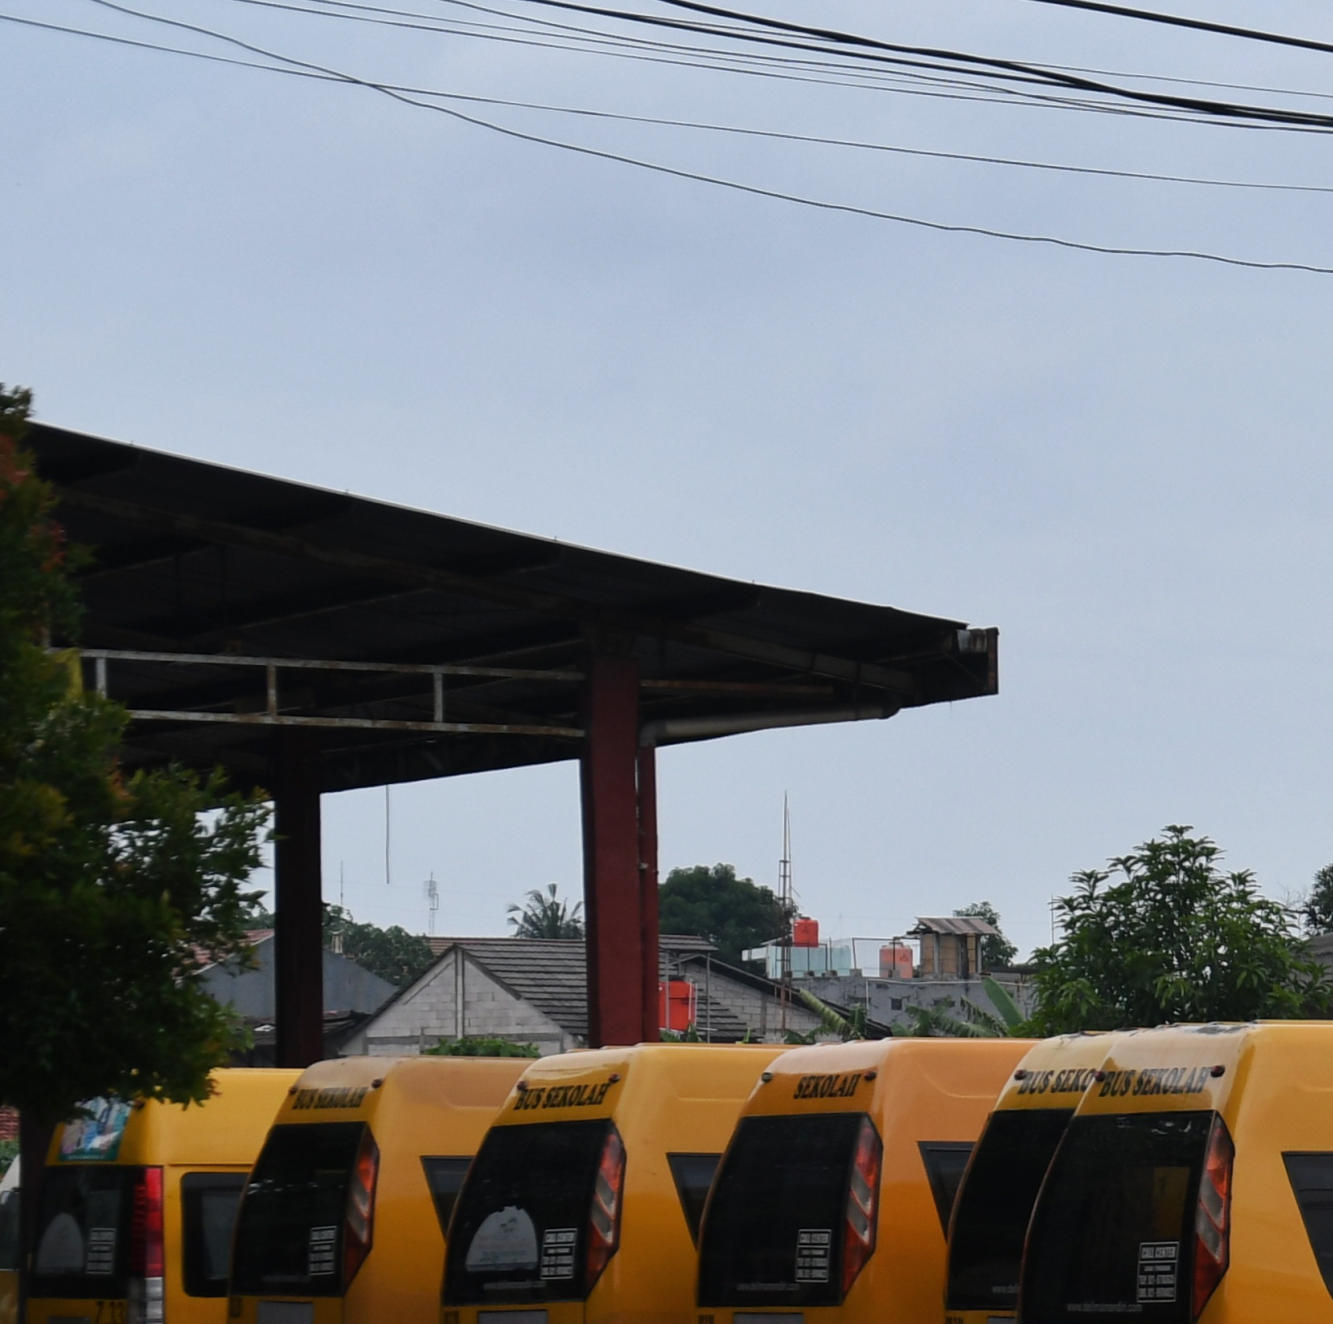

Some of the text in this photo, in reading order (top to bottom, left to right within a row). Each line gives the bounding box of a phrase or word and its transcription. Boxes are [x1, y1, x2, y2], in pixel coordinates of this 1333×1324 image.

[793, 1072, 862, 1100] SEKOLAH
[1018, 1069, 1055, 1095] BUS
[1099, 1066, 1213, 1098] BUS SEKOLAH
[514, 1082, 611, 1111] BUS SEKOLAH
